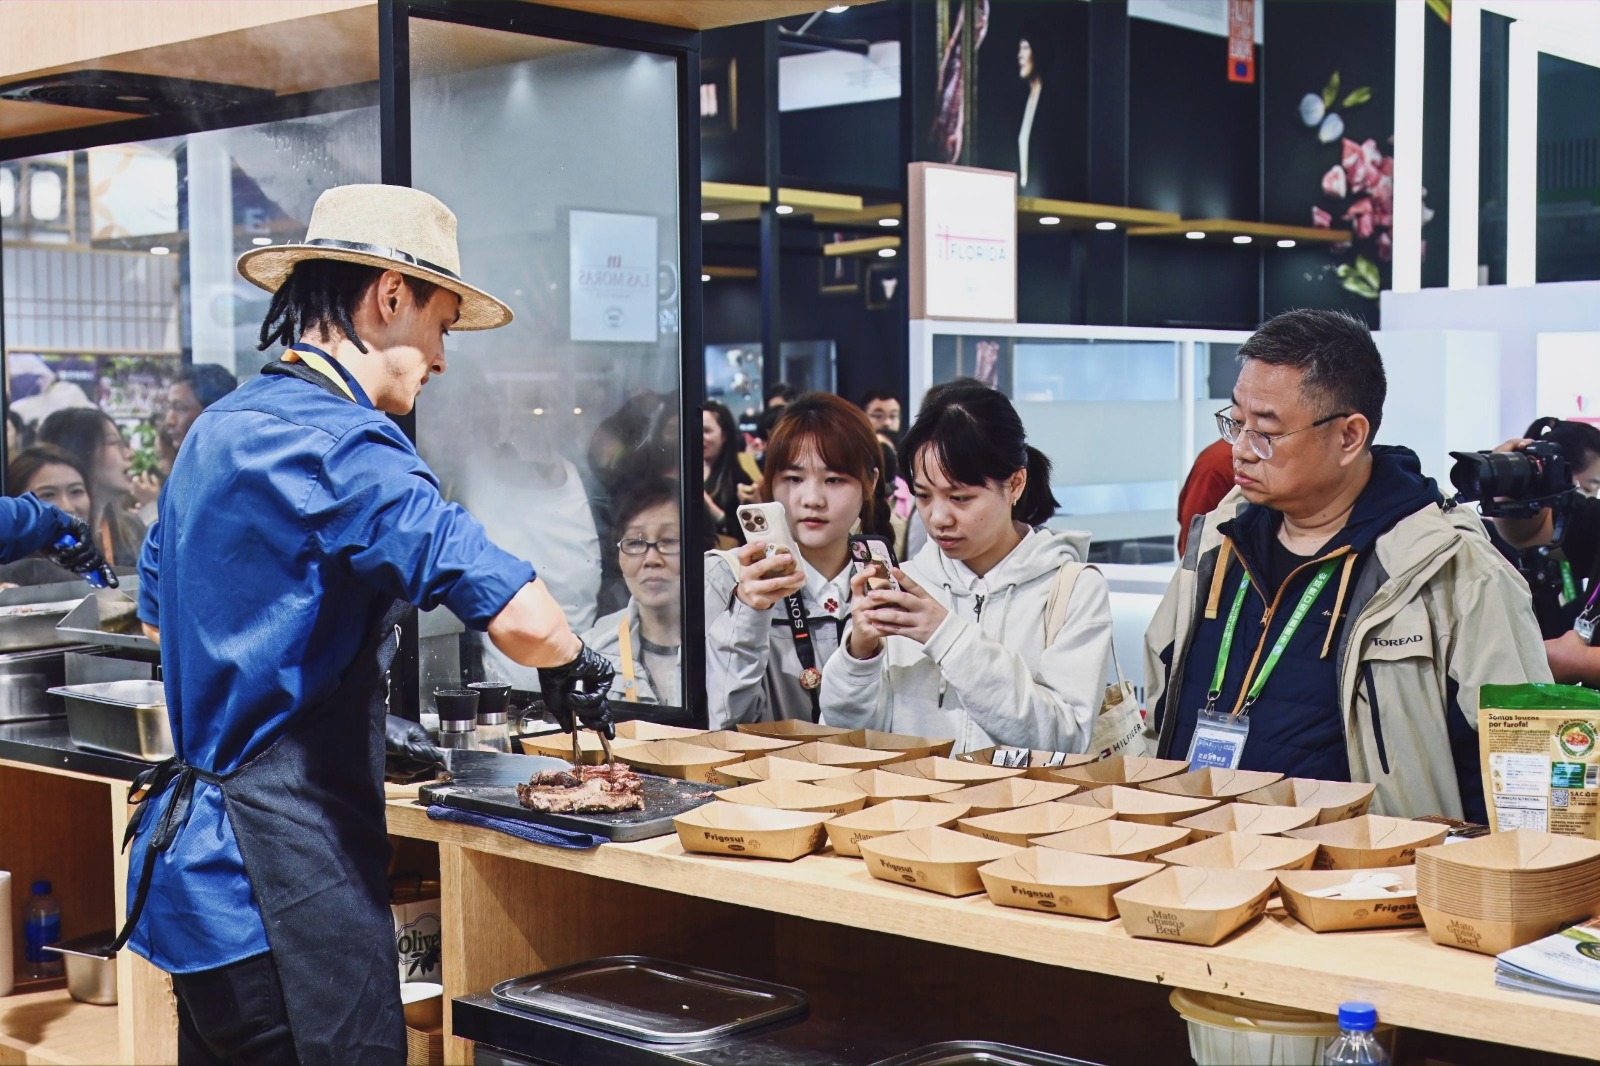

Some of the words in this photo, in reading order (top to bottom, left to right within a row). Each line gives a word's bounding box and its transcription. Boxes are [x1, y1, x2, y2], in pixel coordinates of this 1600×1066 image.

[950, 243, 1006, 262] FLORIDA
[789, 594, 804, 629] SON
[1280, 572, 1327, 643] 中国国际进口博览会
[1370, 634, 1424, 647] TOREAD
[1488, 713, 1513, 721] Somos
[1112, 723, 1142, 752] HILFIGER
[703, 831, 745, 843] Frigosul
[879, 859, 914, 873] Frigosul
[1010, 884, 1055, 899] Frigosul
[1152, 910, 1178, 920] Mato
[1373, 903, 1419, 913] Frigosu
[1155, 924, 1183, 937] Beef
[1450, 919, 1475, 930] Mato
[398, 929, 440, 954] Olive
[1455, 933, 1481, 948] Beef
